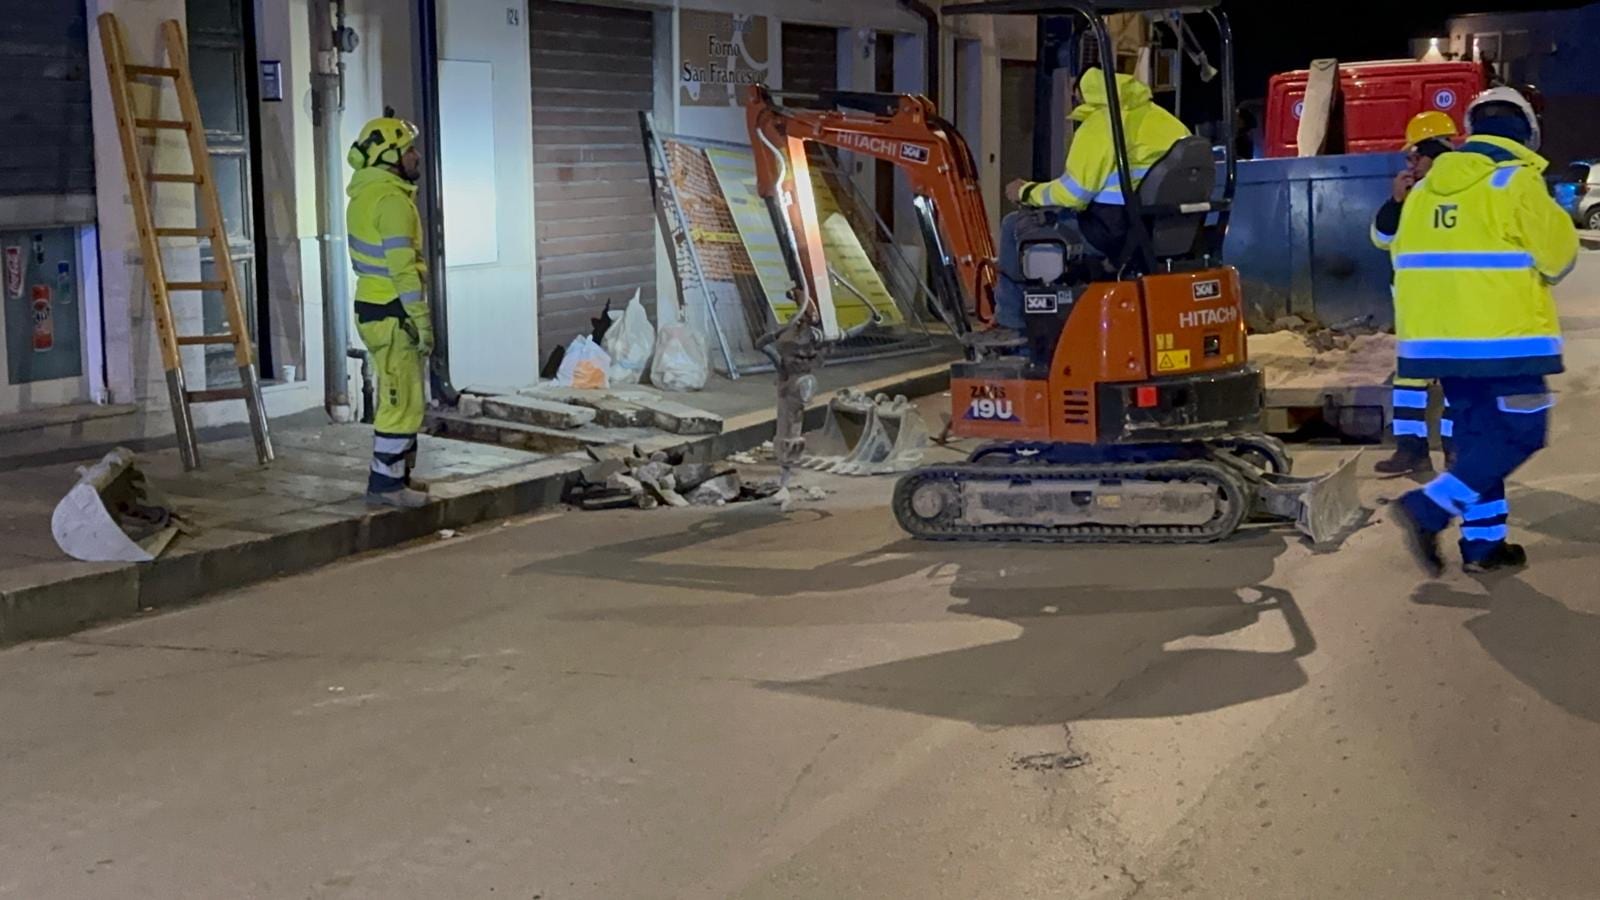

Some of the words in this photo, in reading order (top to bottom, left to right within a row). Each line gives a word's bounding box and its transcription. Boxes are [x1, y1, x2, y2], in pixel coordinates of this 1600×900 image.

[708, 35, 741, 57] Forno
[683, 62, 706, 82] San
[710, 63, 765, 84] Francesco
[837, 131, 898, 157] HITACHI
[1179, 305, 1237, 328] HITACHI
[970, 398, 1013, 419] 19U
